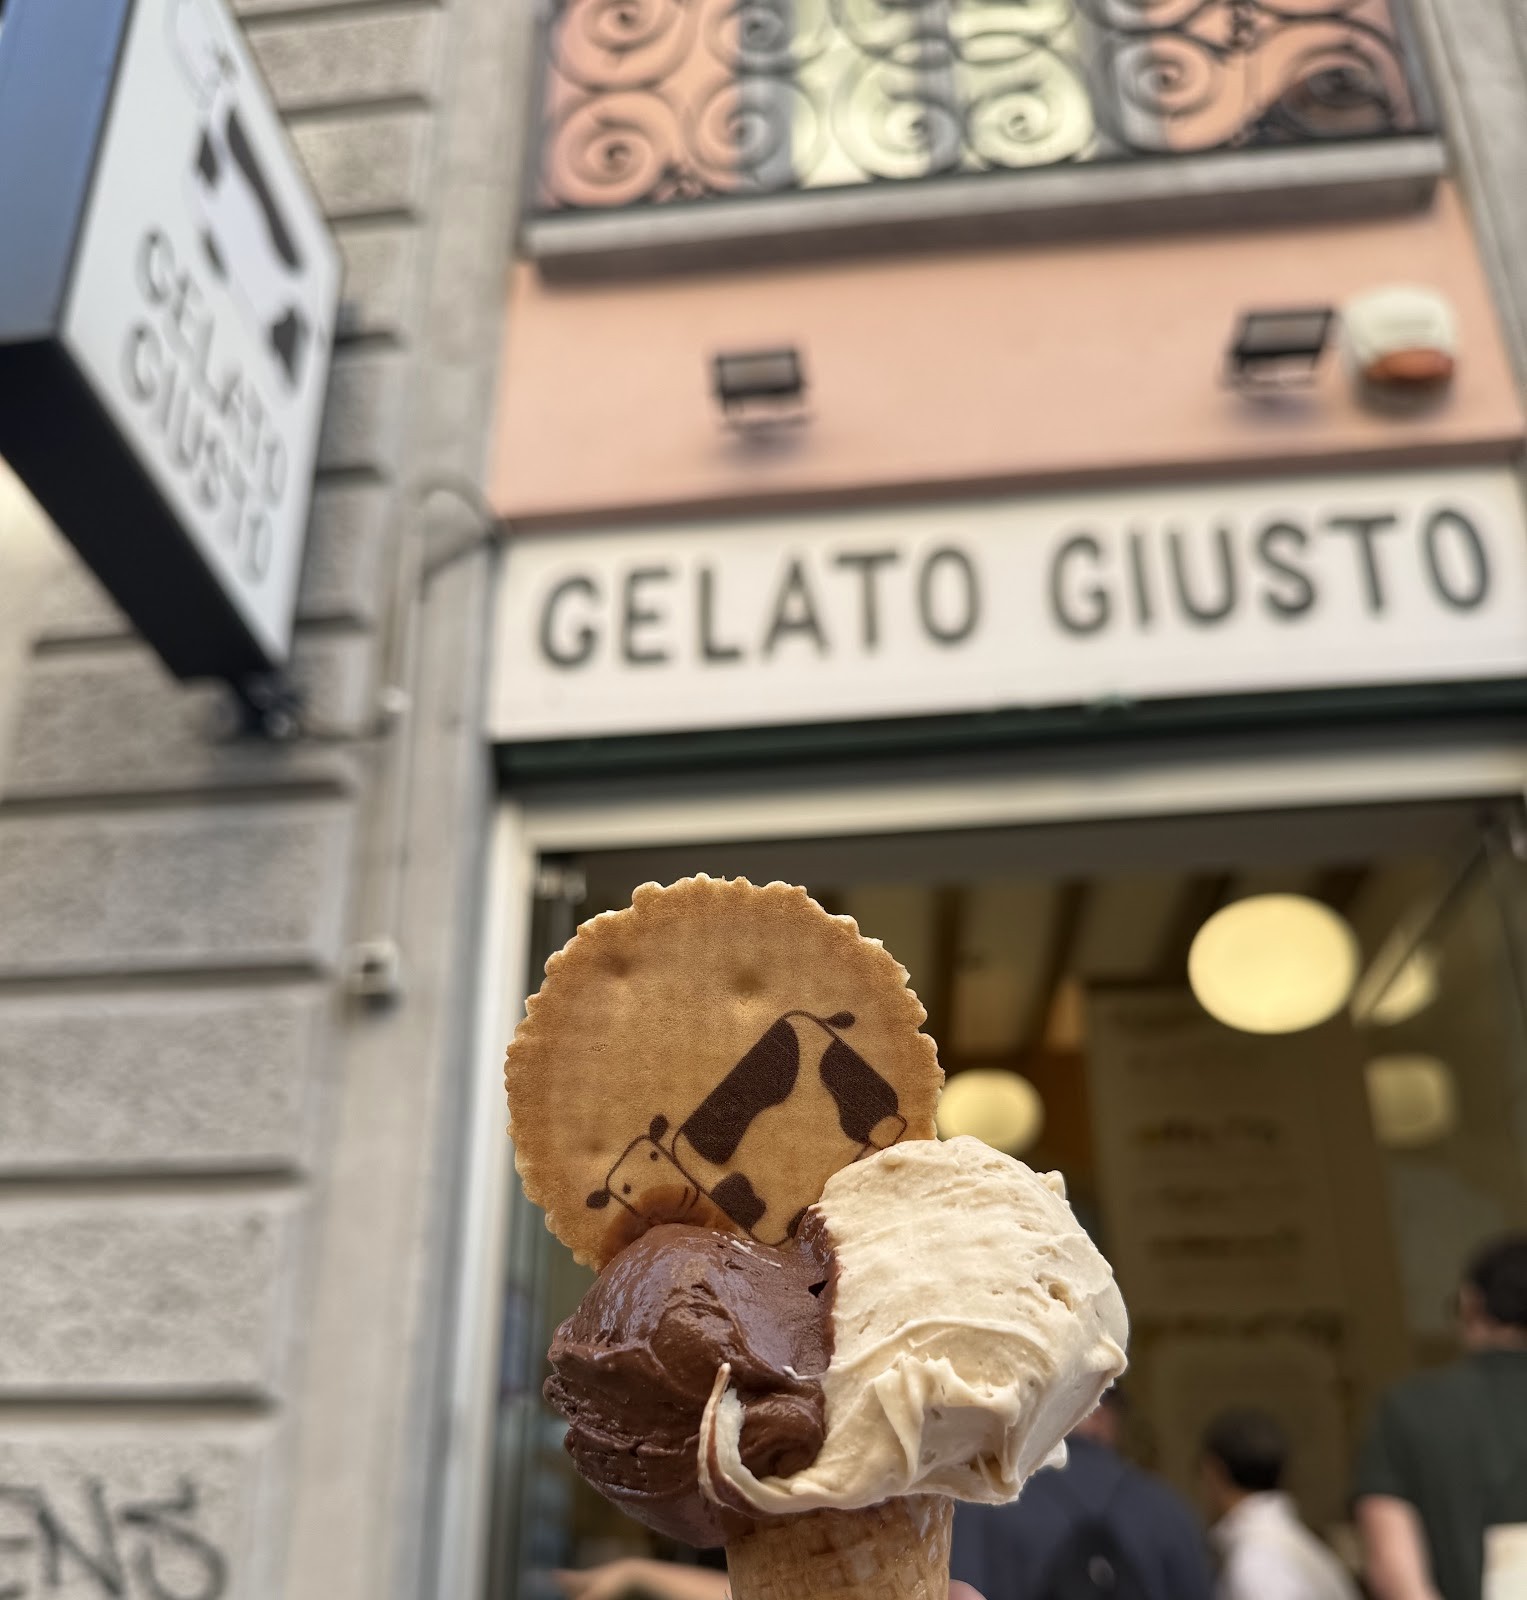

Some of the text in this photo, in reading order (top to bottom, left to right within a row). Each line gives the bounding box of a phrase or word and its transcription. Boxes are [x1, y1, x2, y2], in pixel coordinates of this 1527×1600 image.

[122, 323, 273, 584] GIUSTO
[136, 227, 287, 508] GELATO
[538, 507, 1492, 670] GELATO GIUSTO
